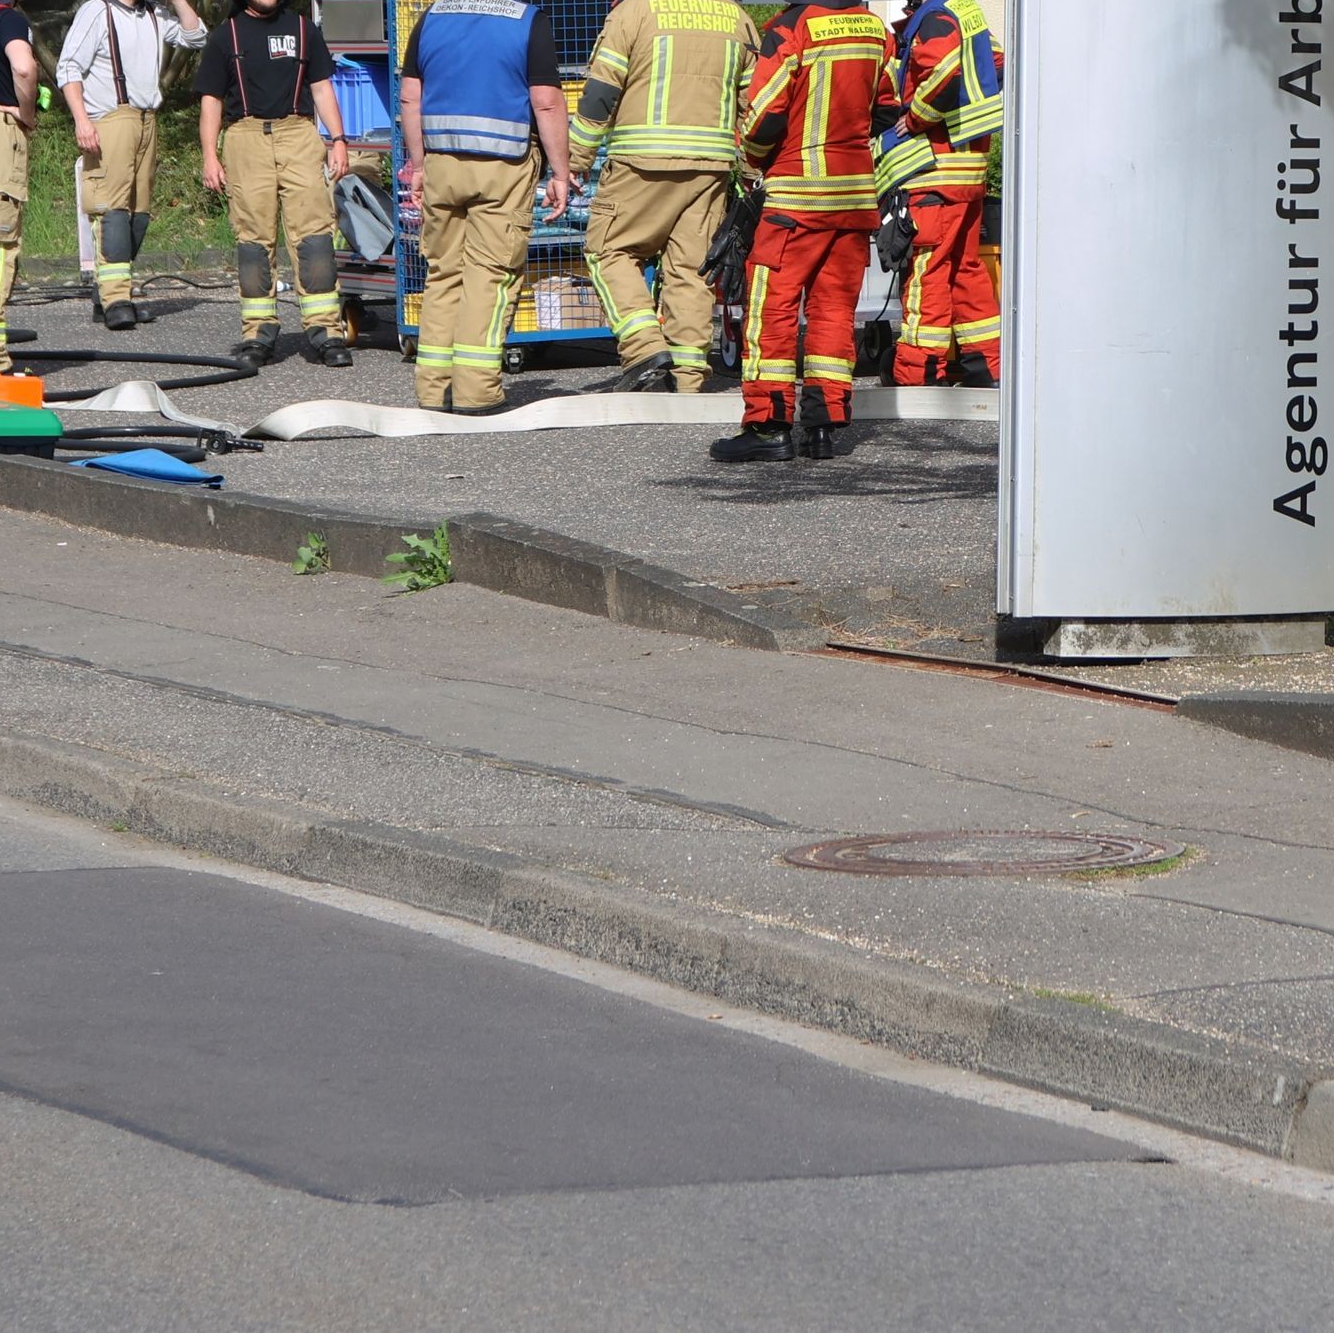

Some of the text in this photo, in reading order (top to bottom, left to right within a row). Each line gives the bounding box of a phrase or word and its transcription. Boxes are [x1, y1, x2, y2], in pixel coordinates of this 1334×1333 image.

[657, 12, 737, 34] REICHSHOF
[829, 16, 873, 25] FEUERWEHR
[814, 27, 845, 39] STADT
[1276, 124, 1320, 224] für
[1274, 244, 1327, 527] Agentur
